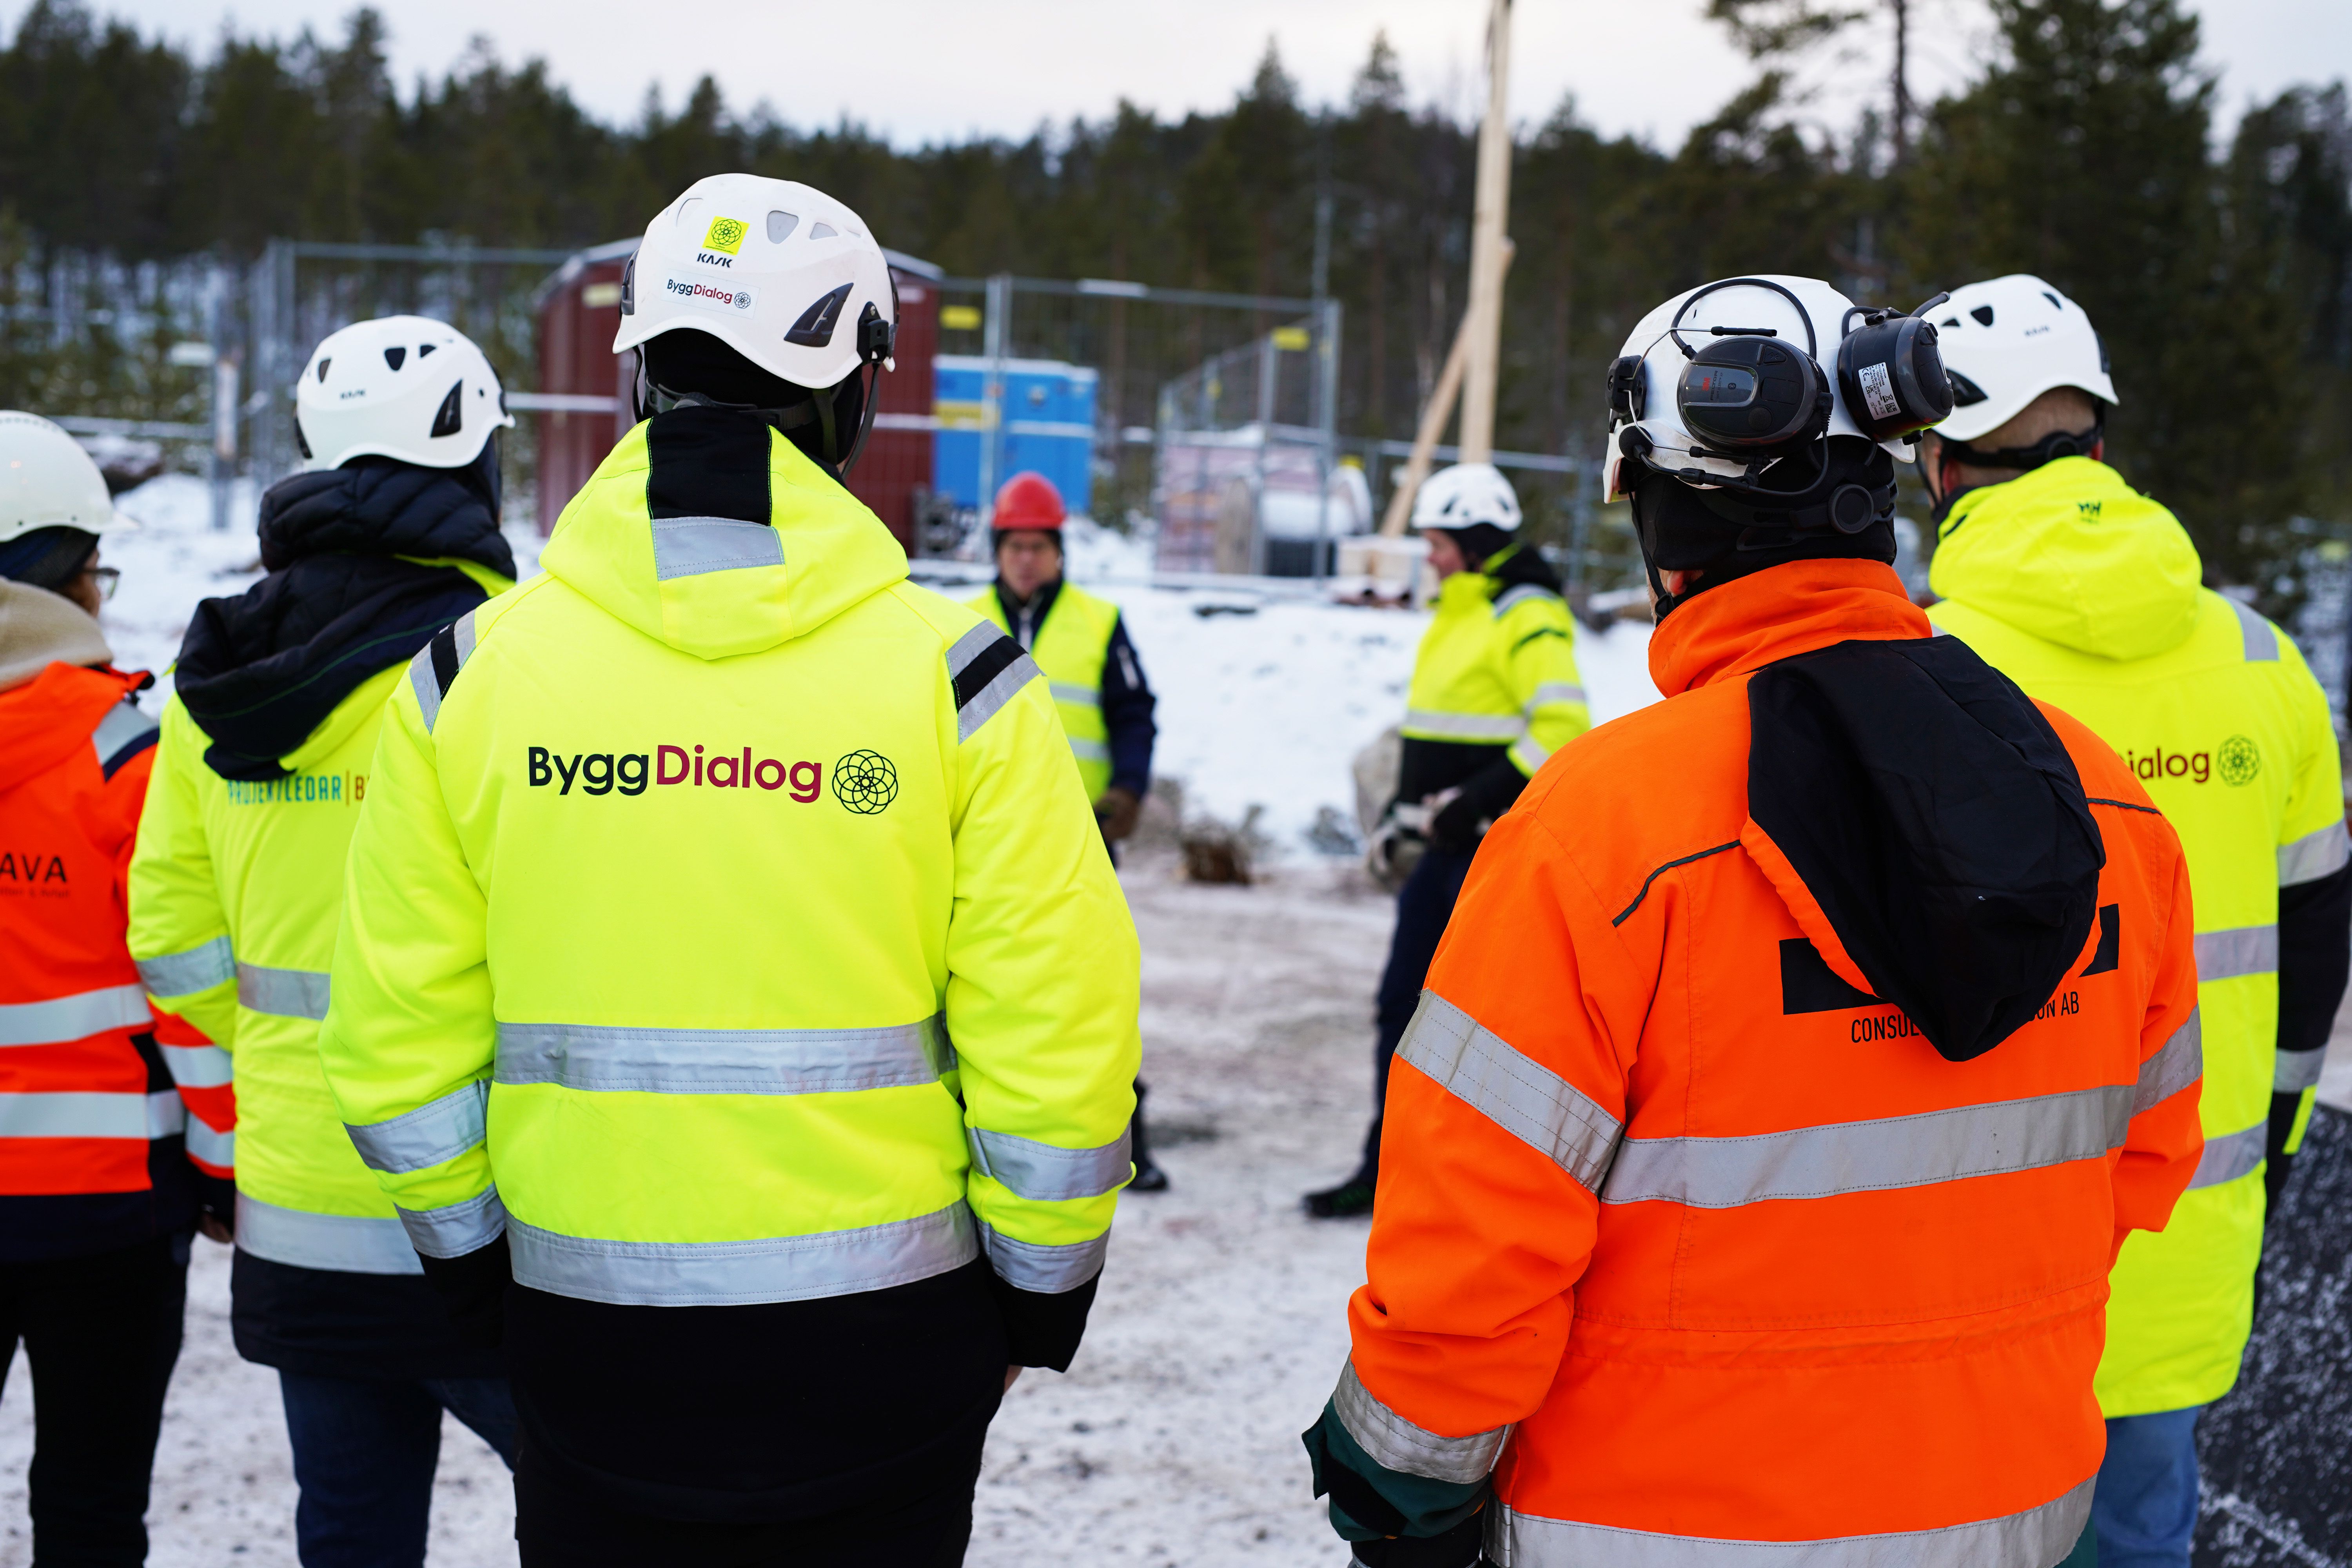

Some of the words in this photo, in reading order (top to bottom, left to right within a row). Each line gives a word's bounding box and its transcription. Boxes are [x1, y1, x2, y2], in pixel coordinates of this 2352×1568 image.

[697, 253, 733, 268] KASK
[667, 279, 733, 304] ByggDialog
[1702, 377, 1711, 392] 3M
[528, 744, 822, 803] ByggDialog
[2118, 748, 2210, 783] ialog
[1851, 1014, 1920, 1043] CONSUL
[2031, 999, 2055, 1022] ON
[2061, 991, 2079, 1016] AB
